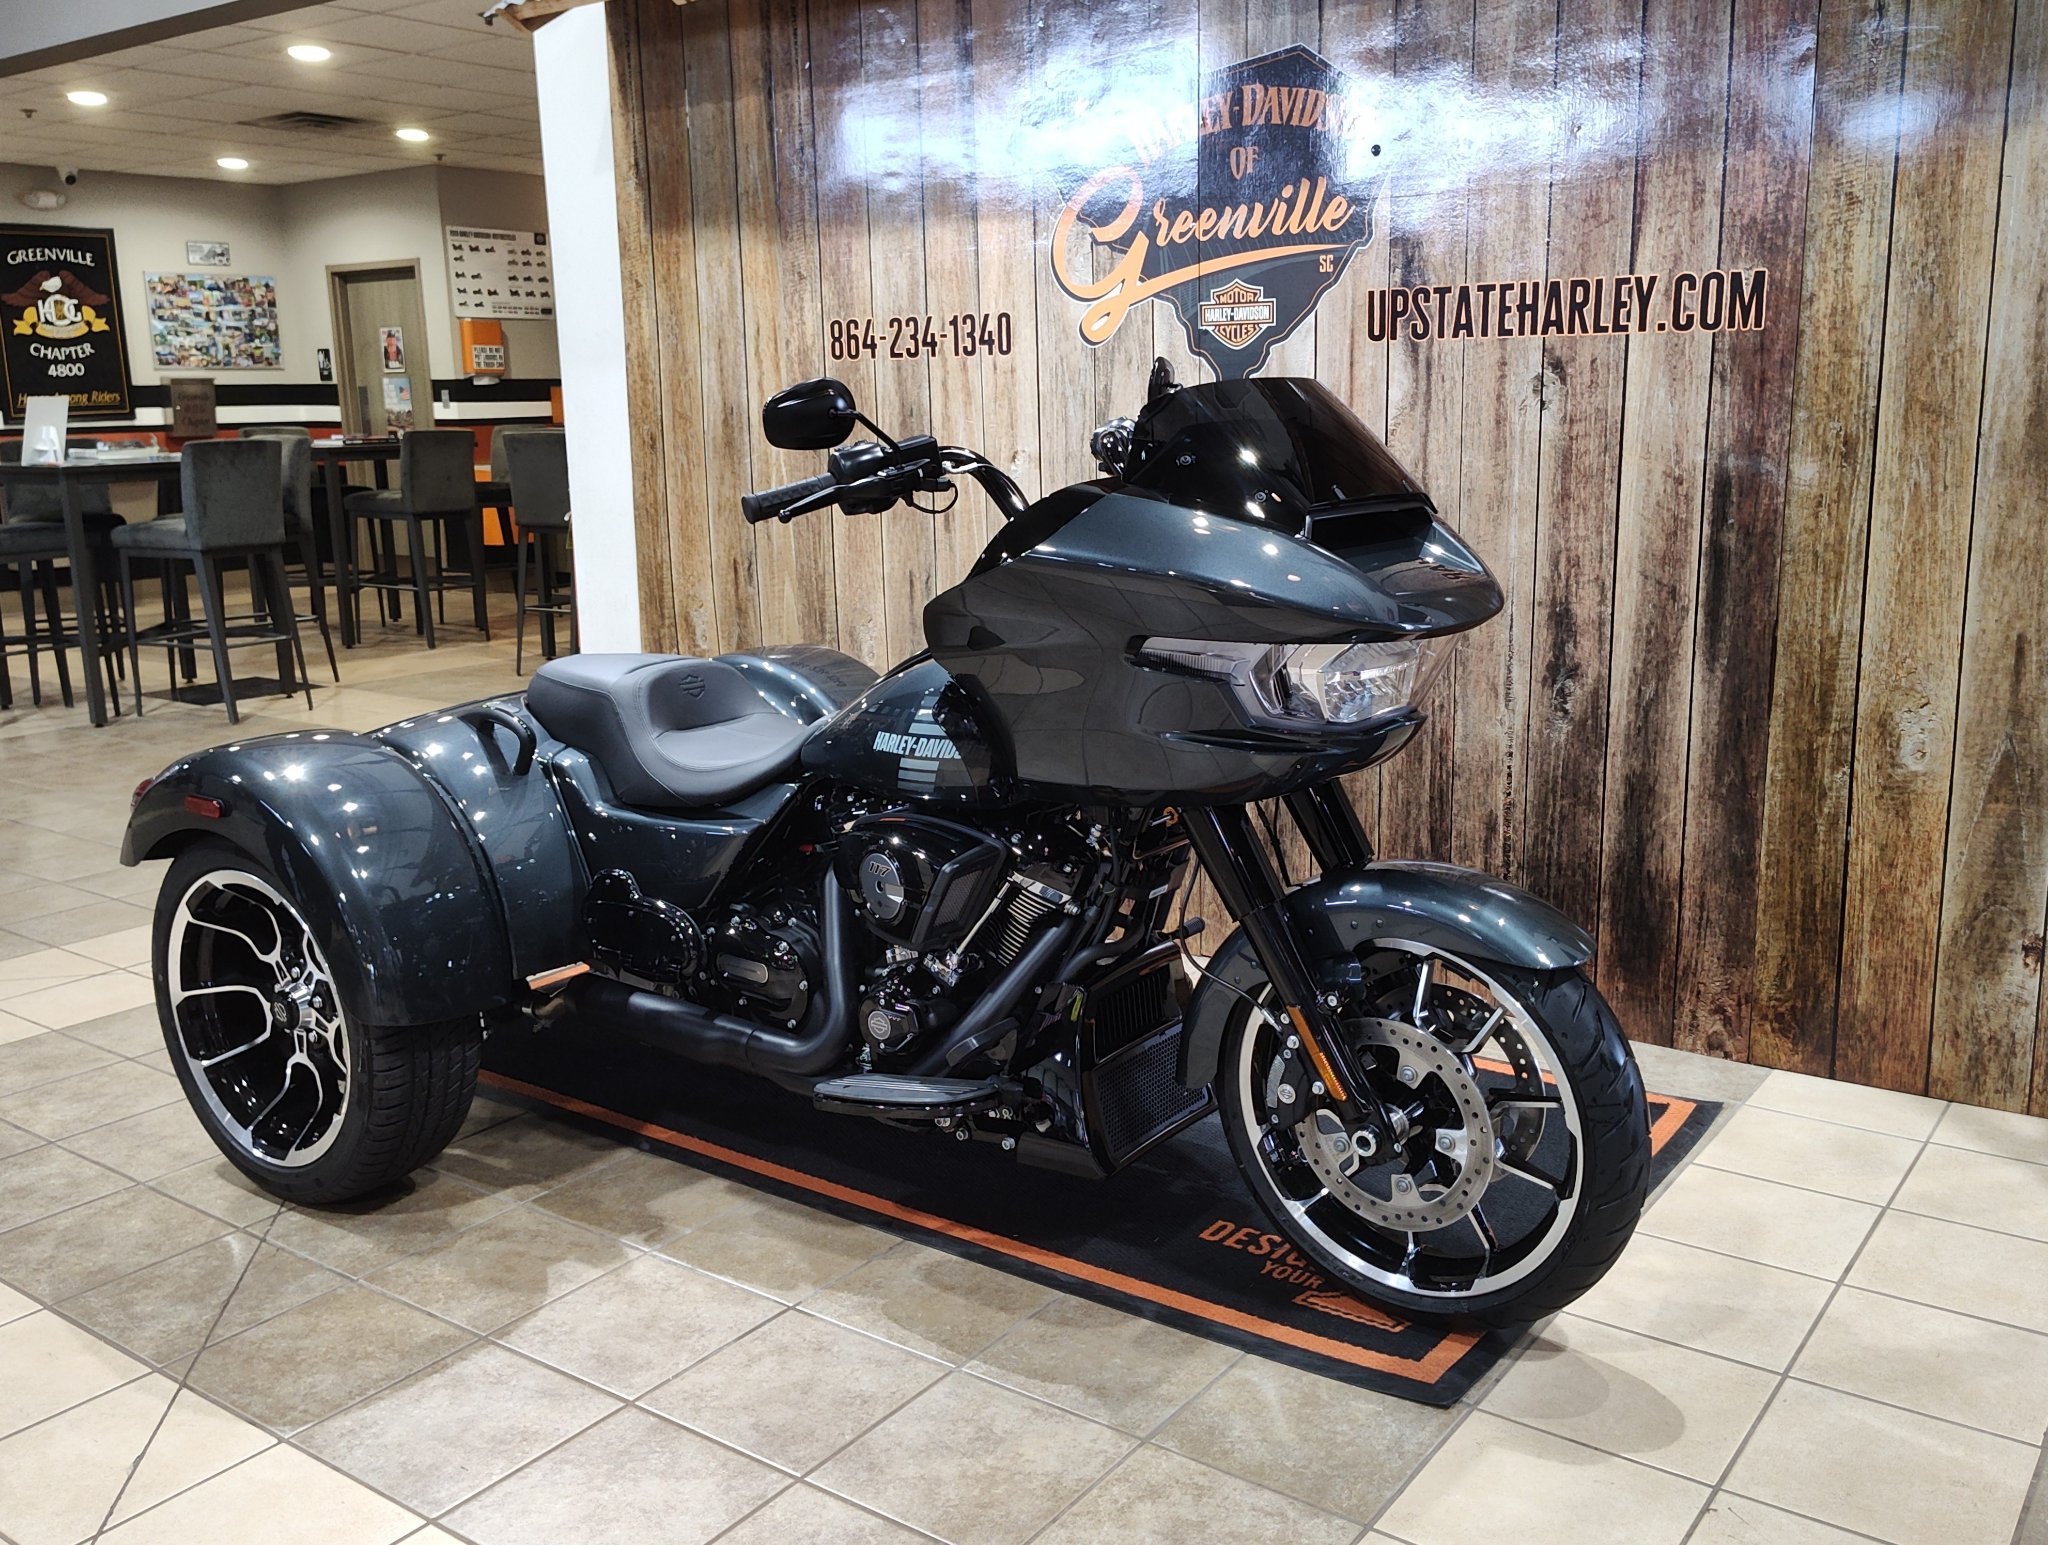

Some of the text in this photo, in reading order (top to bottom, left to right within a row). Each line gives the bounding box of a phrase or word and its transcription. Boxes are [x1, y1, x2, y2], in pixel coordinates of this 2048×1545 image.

[1230, 146, 1259, 180] OF
[7, 248, 95, 267] GREENVILLE
[1052, 166, 1355, 343] Greenville
[1319, 254, 1334, 273] SC
[1220, 288, 1254, 304] MOTOR
[1367, 268, 1768, 342] UPSTATEHARLEY.COM
[1205, 305, 1270, 322] HARLEY-DAVIDSON
[829, 311, 1012, 361] 864-234-1340
[1220, 324, 1254, 342] CYCLES
[29, 342, 95, 361] CHAPTER
[48, 362, 85, 378] 4800
[92, 390, 120, 403] Riders
[873, 731, 961, 760] HARLEY-DAVID
[868, 861, 891, 877] 117
[1199, 1220, 1308, 1268] DESI
[1260, 1261, 1325, 1289] YOUR
